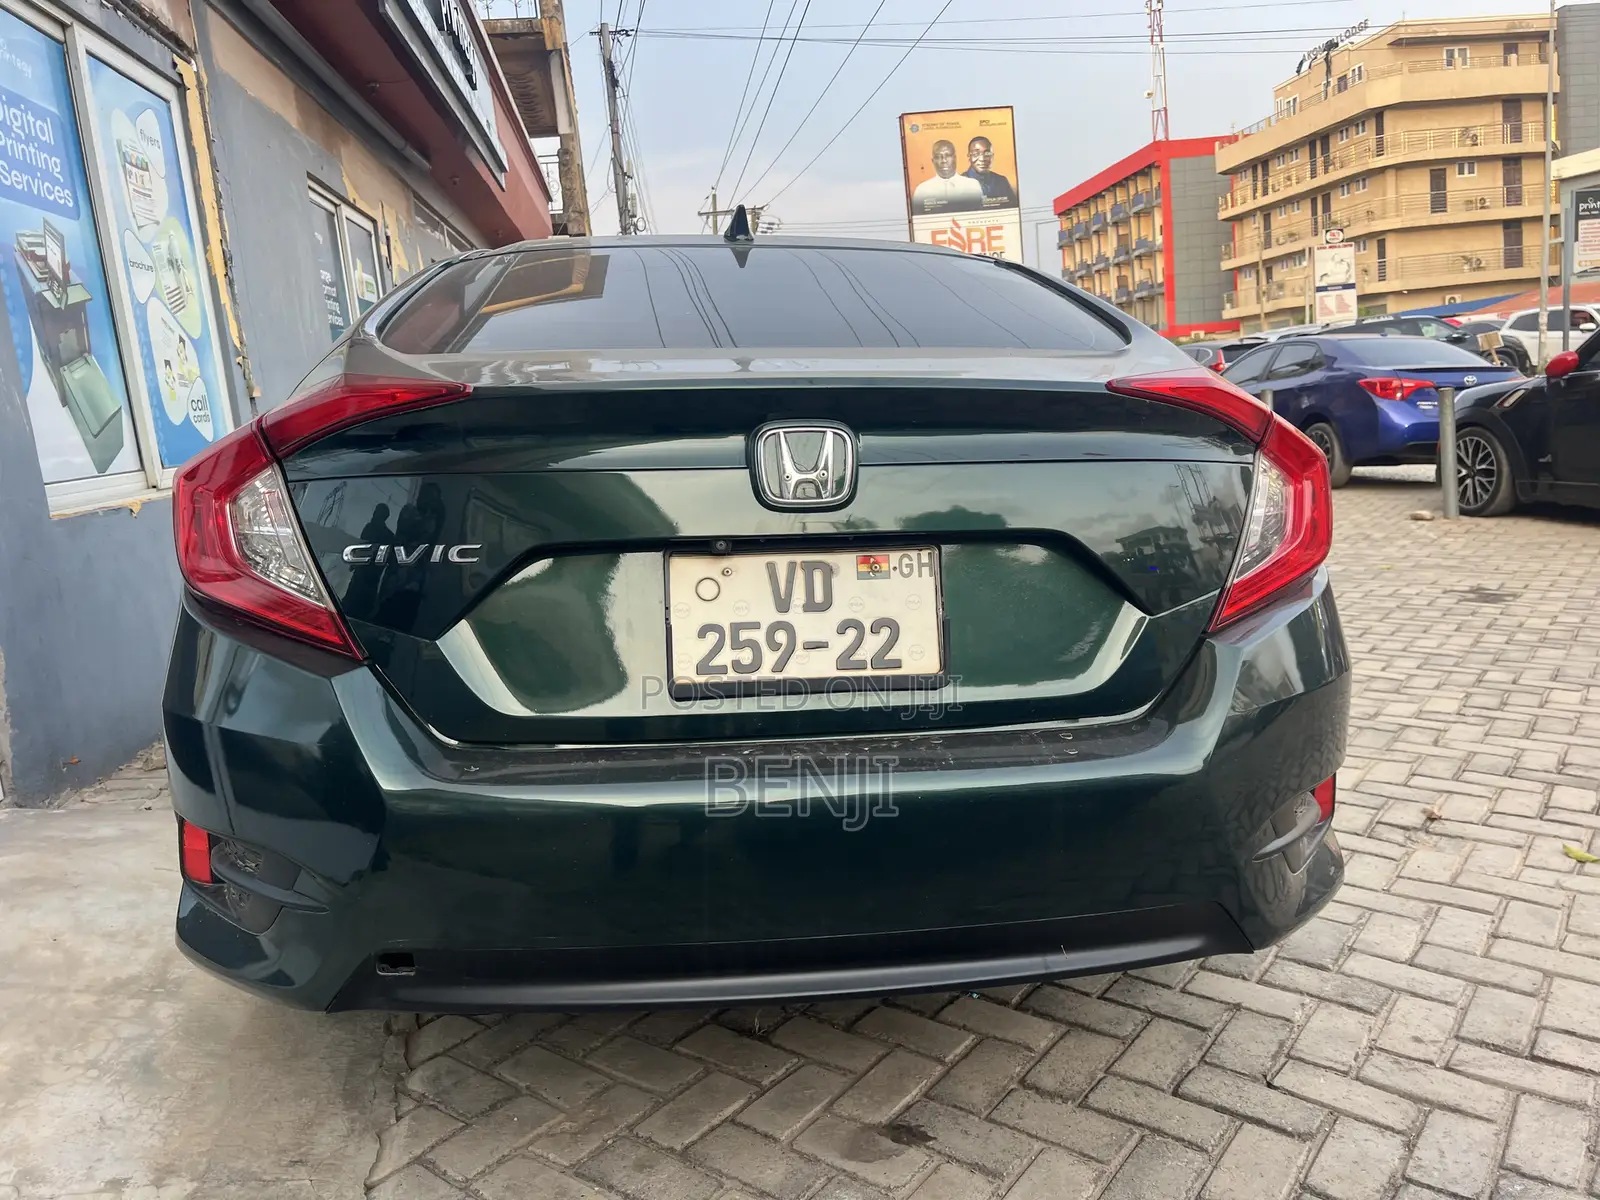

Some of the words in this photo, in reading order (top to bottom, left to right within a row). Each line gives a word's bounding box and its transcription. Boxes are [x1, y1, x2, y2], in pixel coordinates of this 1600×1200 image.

[1339, 18, 1369, 42] LODGE
[0, 95, 54, 145] igital
[0, 160, 73, 208] Services
[128, 258, 154, 273] brochure
[191, 395, 208, 412] call
[193, 411, 211, 424] cards
[342, 543, 483, 565] CIVIC
[897, 552, 934, 579] GH
[765, 560, 834, 614] VD
[696, 617, 903, 676] 259-22
